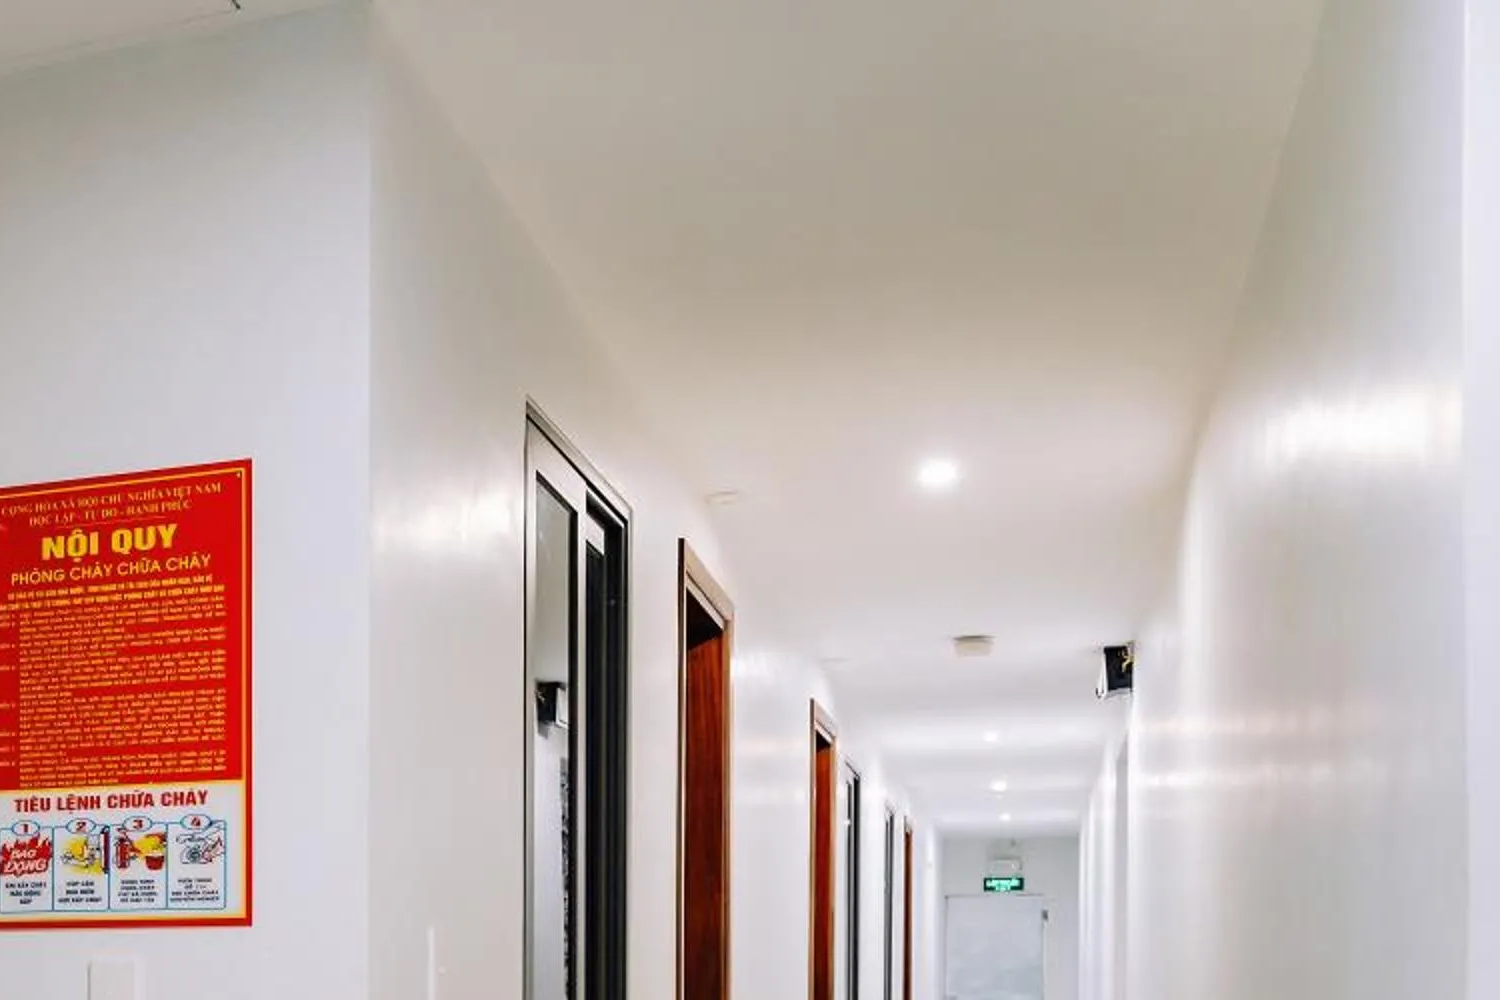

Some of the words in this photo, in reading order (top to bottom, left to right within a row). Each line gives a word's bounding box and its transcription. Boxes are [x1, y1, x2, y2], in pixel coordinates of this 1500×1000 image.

[195, 482, 221, 494] NAM
[41, 527, 99, 562] NỘI
[111, 523, 177, 555] QUY
[11, 567, 65, 587] PHÒNG
[69, 561, 113, 581] CHÁY
[117, 556, 161, 575] CHỮA
[165, 551, 211, 572] CHÁY
[14, 795, 51, 813] TIÊU
[57, 793, 101, 814] LỆNH
[107, 789, 154, 809] CHỮA
[161, 787, 208, 807] CHÁY
[75, 821, 86, 832] 2
[133, 819, 143, 829] 3
[190, 817, 201, 827] 4
[20, 823, 28, 833] 1
